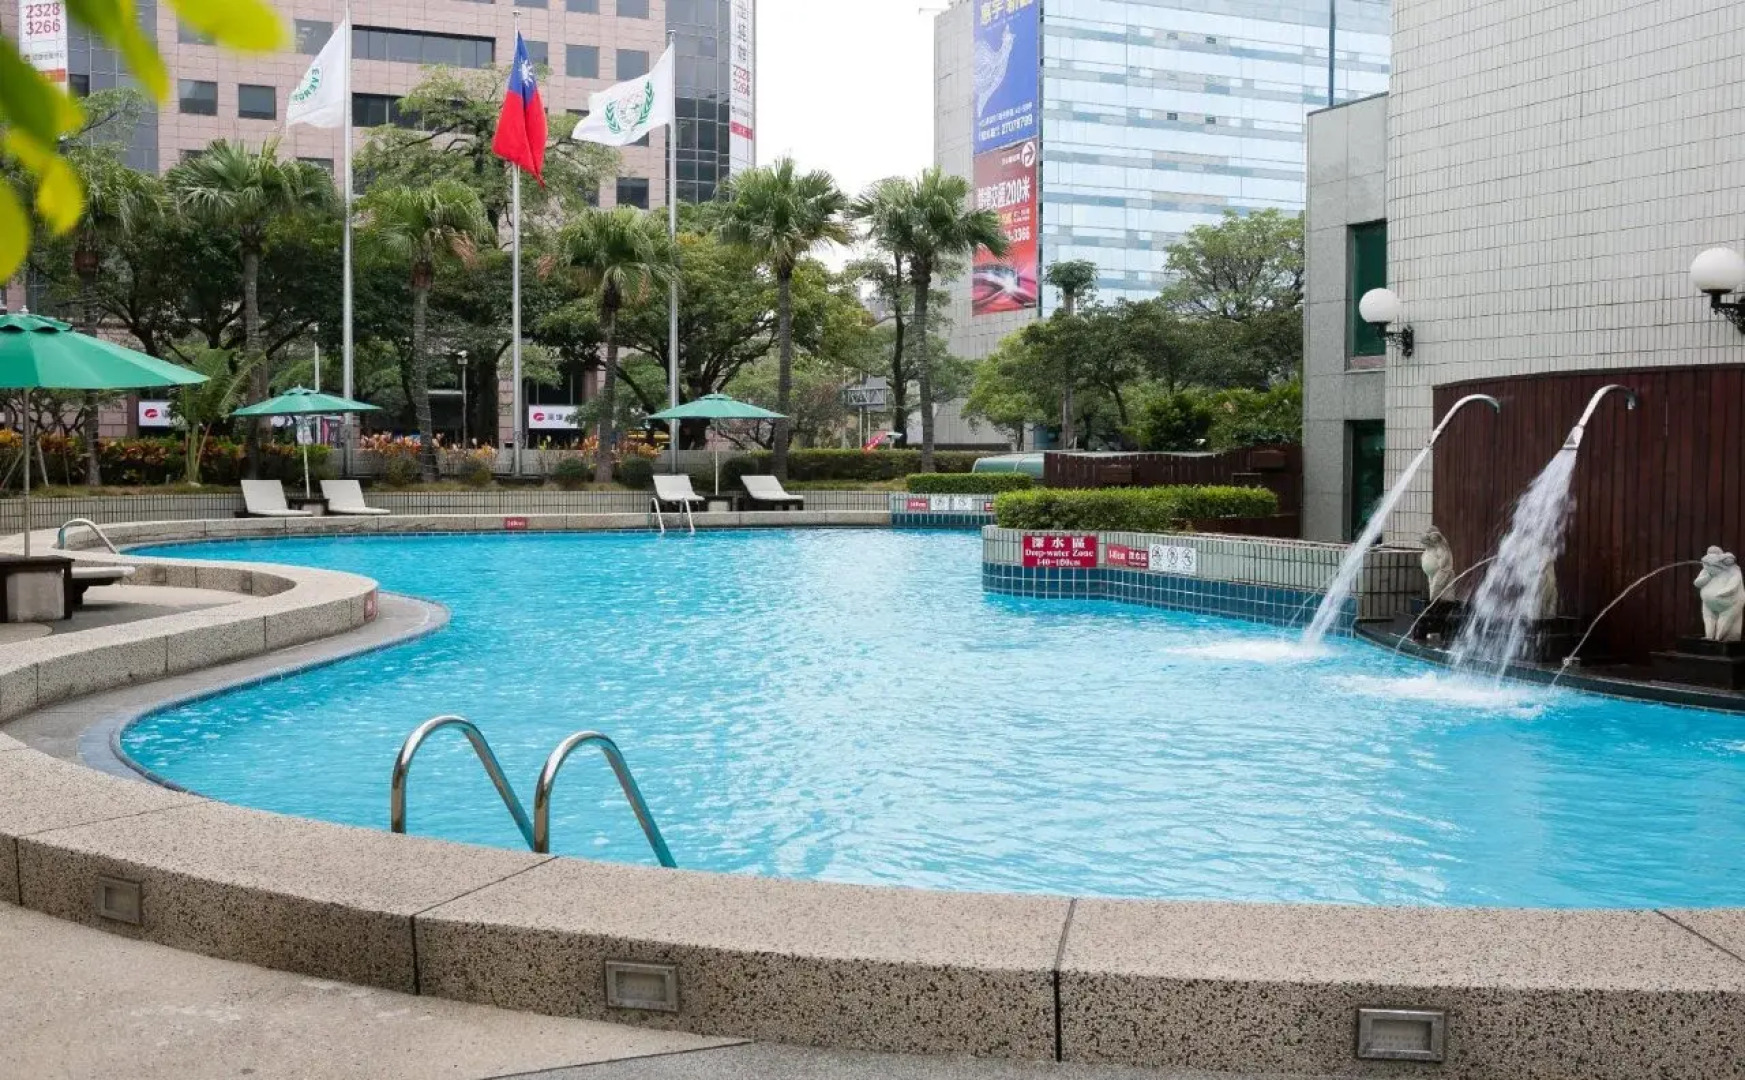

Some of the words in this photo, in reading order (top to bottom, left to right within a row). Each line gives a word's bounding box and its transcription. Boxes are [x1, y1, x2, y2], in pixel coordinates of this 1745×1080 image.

[25, 2, 61, 18] 2328
[25, 18, 61, 35] 3266
[1025, 549, 1070, 558] Deep-water
[1072, 549, 1094, 557] Zone
